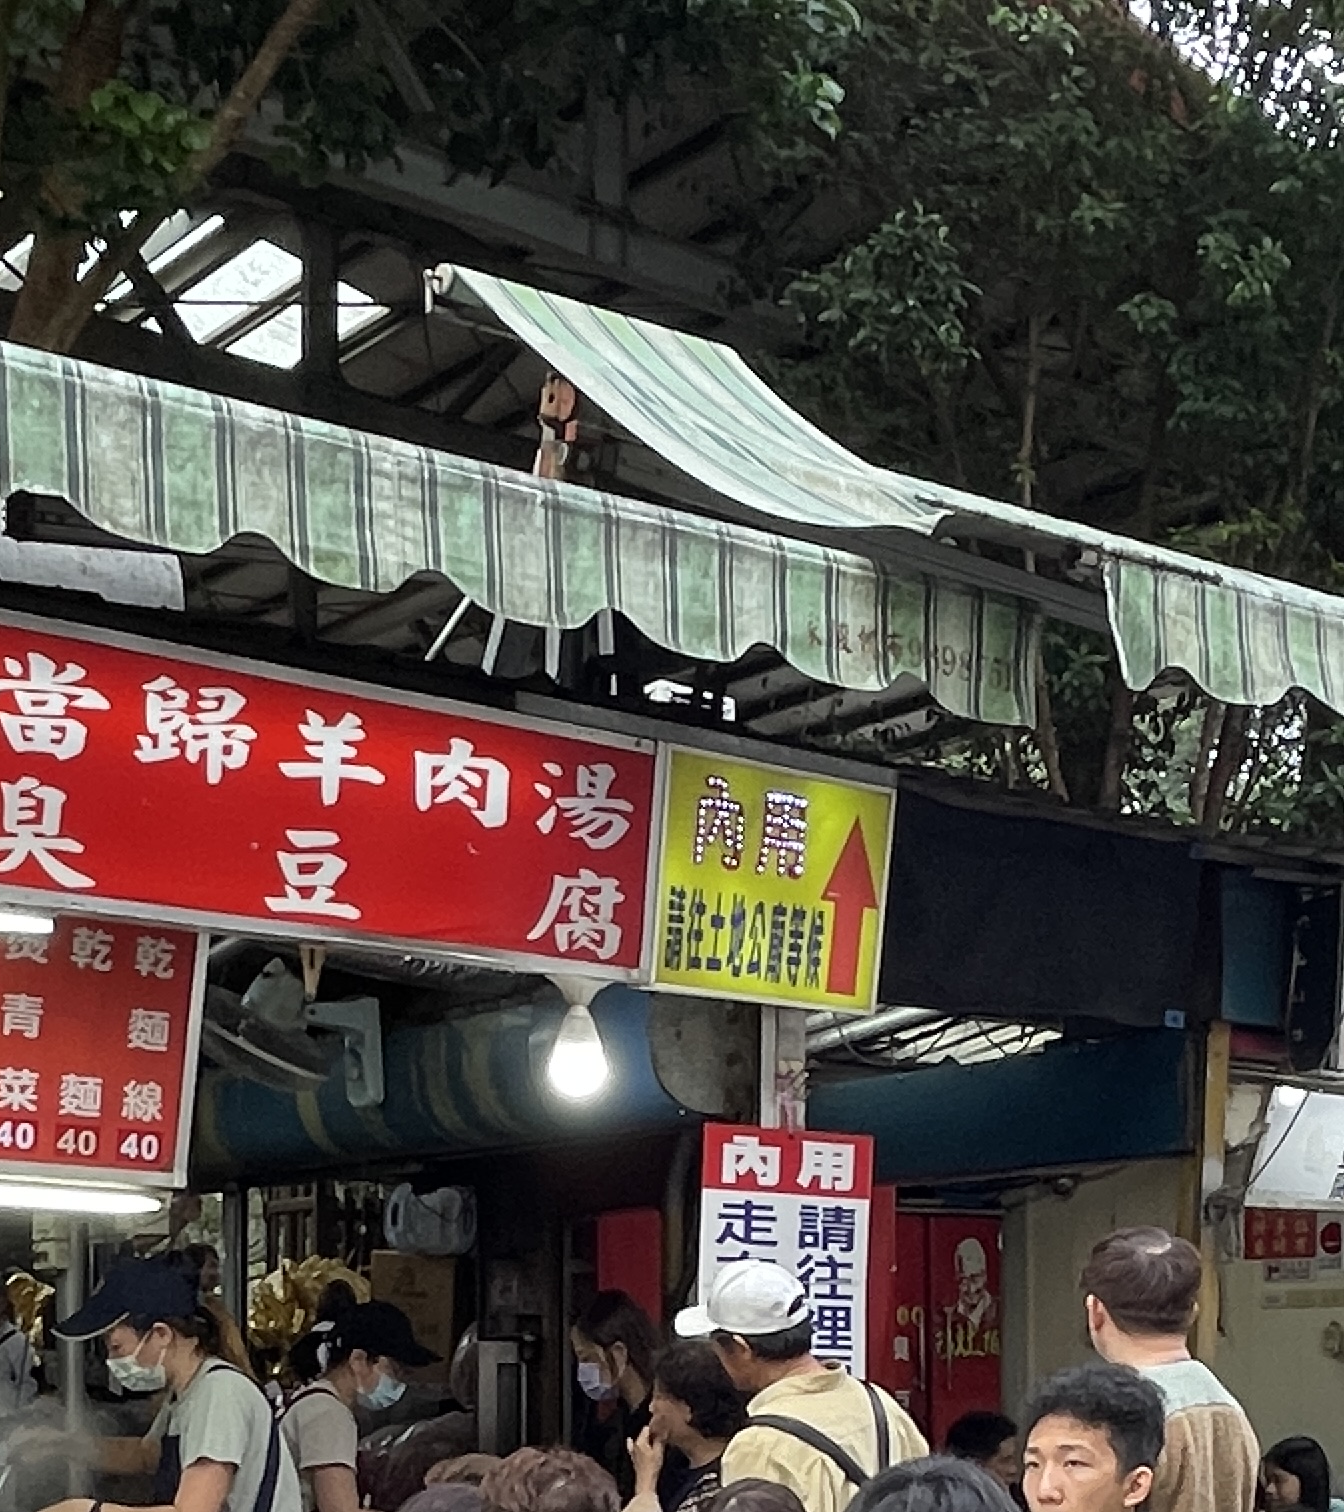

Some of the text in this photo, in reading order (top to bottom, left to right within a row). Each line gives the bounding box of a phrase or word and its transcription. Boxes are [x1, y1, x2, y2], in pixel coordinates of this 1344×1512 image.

[56, 1128, 97, 1156] 40
[120, 1132, 160, 1161] 40
[720, 1134, 856, 1192] 內用
[796, 1204, 857, 1376] 請往裡
